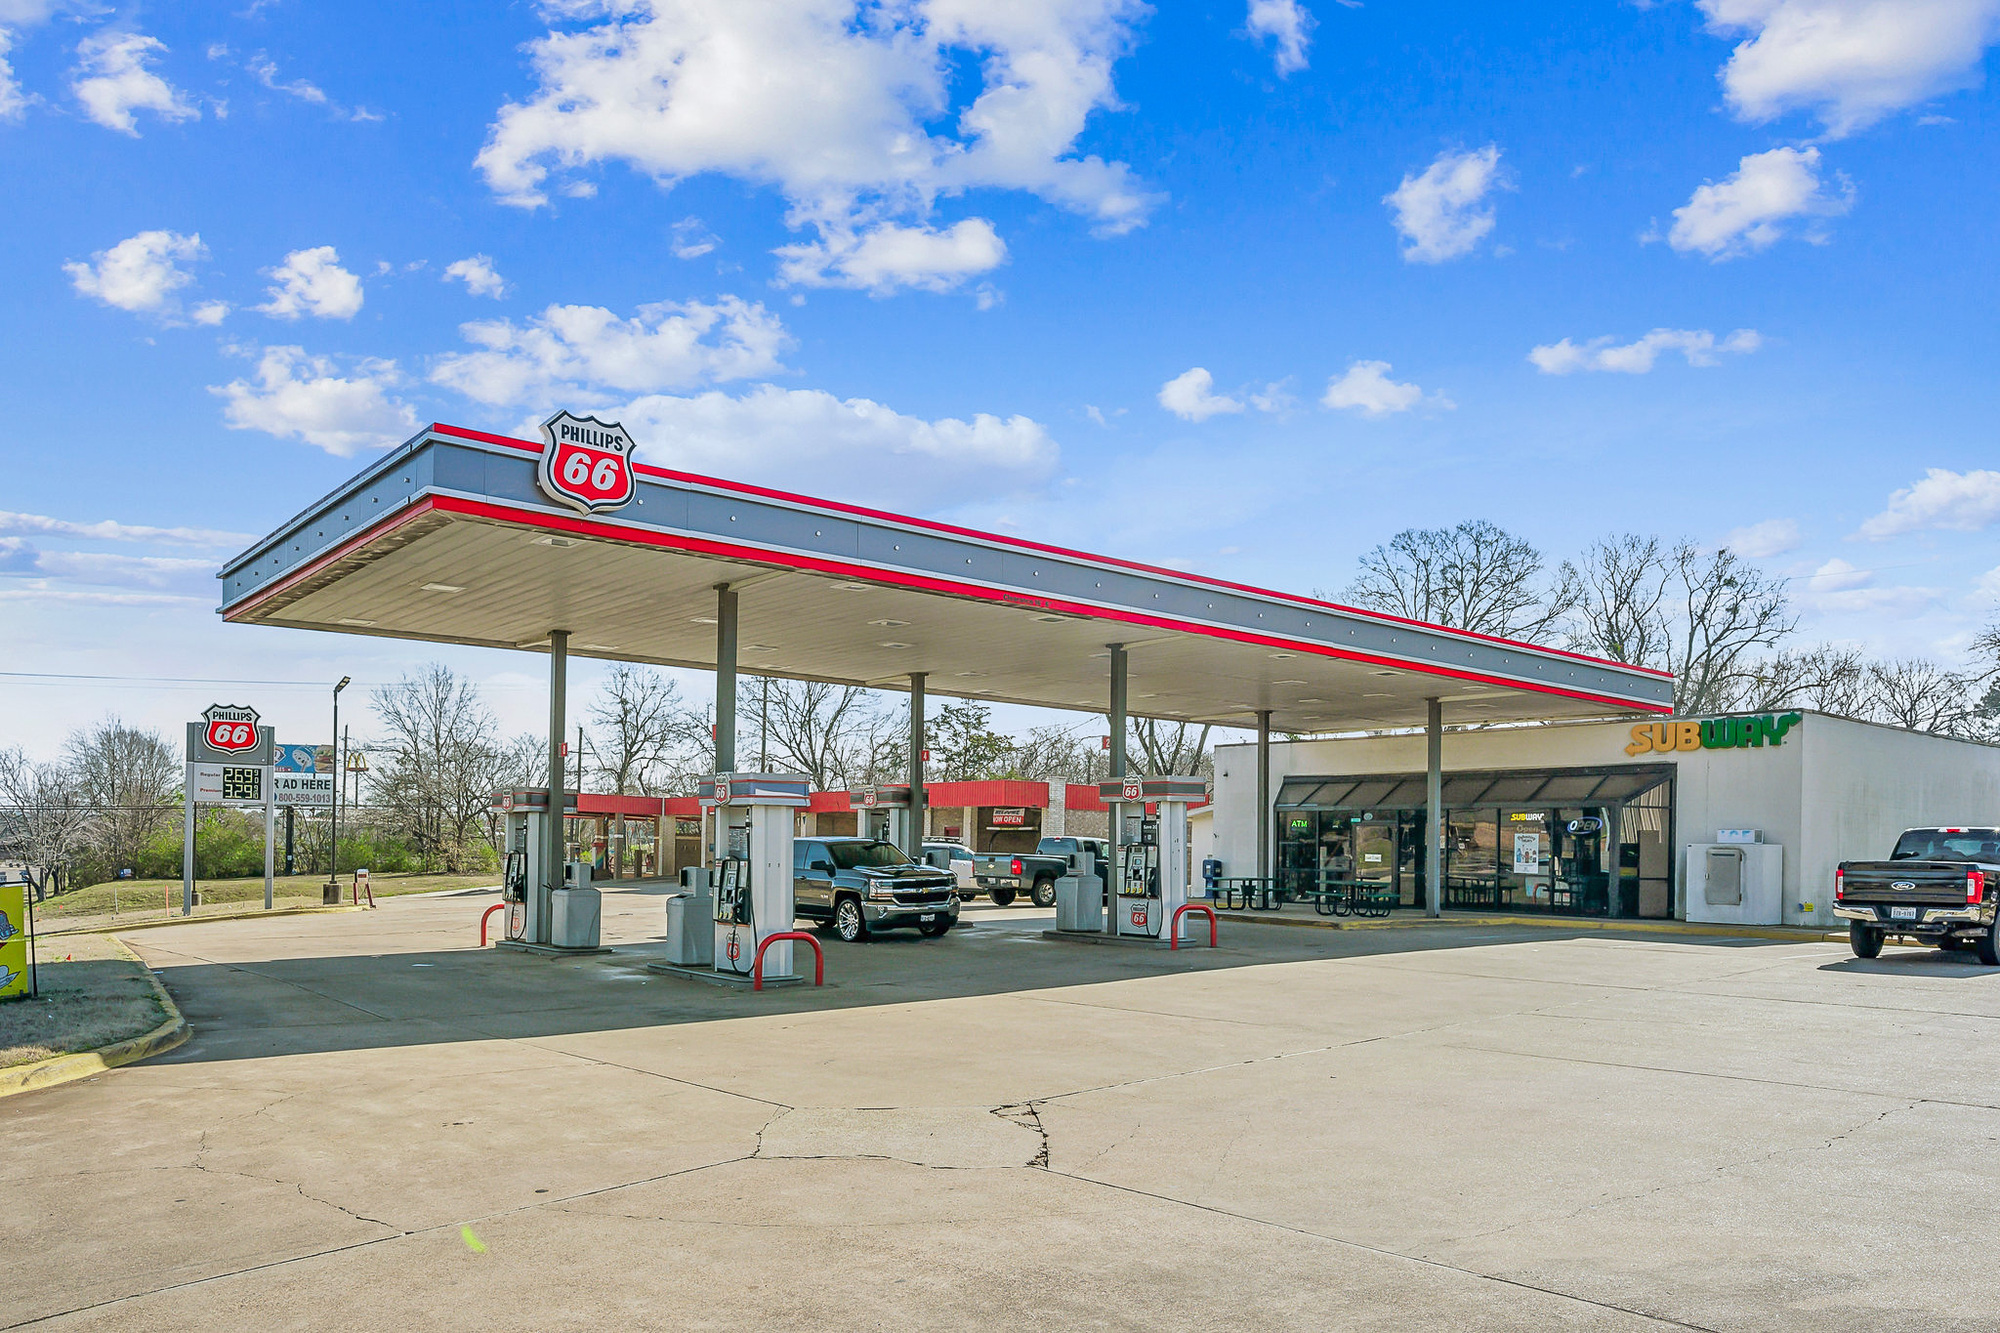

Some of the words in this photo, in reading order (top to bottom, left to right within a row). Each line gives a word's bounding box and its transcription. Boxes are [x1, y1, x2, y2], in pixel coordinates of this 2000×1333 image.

[561, 423, 624, 452] PHILLIPS
[563, 452, 619, 491] 66
[212, 710, 252, 722] PHILLIPS
[214, 724, 250, 744] 66
[1624, 711, 1803, 757] SUBWAY
[224, 768, 253, 783] 2.69
[282, 779, 298, 789] AD
[301, 779, 331, 790] HERE
[224, 783, 253, 799] 3.29
[716, 786, 727, 798] 66
[1124, 787, 1138, 797] 66
[278, 793, 331, 803] 800-559-1013
[1510, 813, 1545, 821] SUBWAY
[1291, 820, 1308, 828] ATM
[1516, 824, 1539, 833] Open
[1569, 820, 1599, 831] OPEN
[1133, 914, 1146, 923] 66
